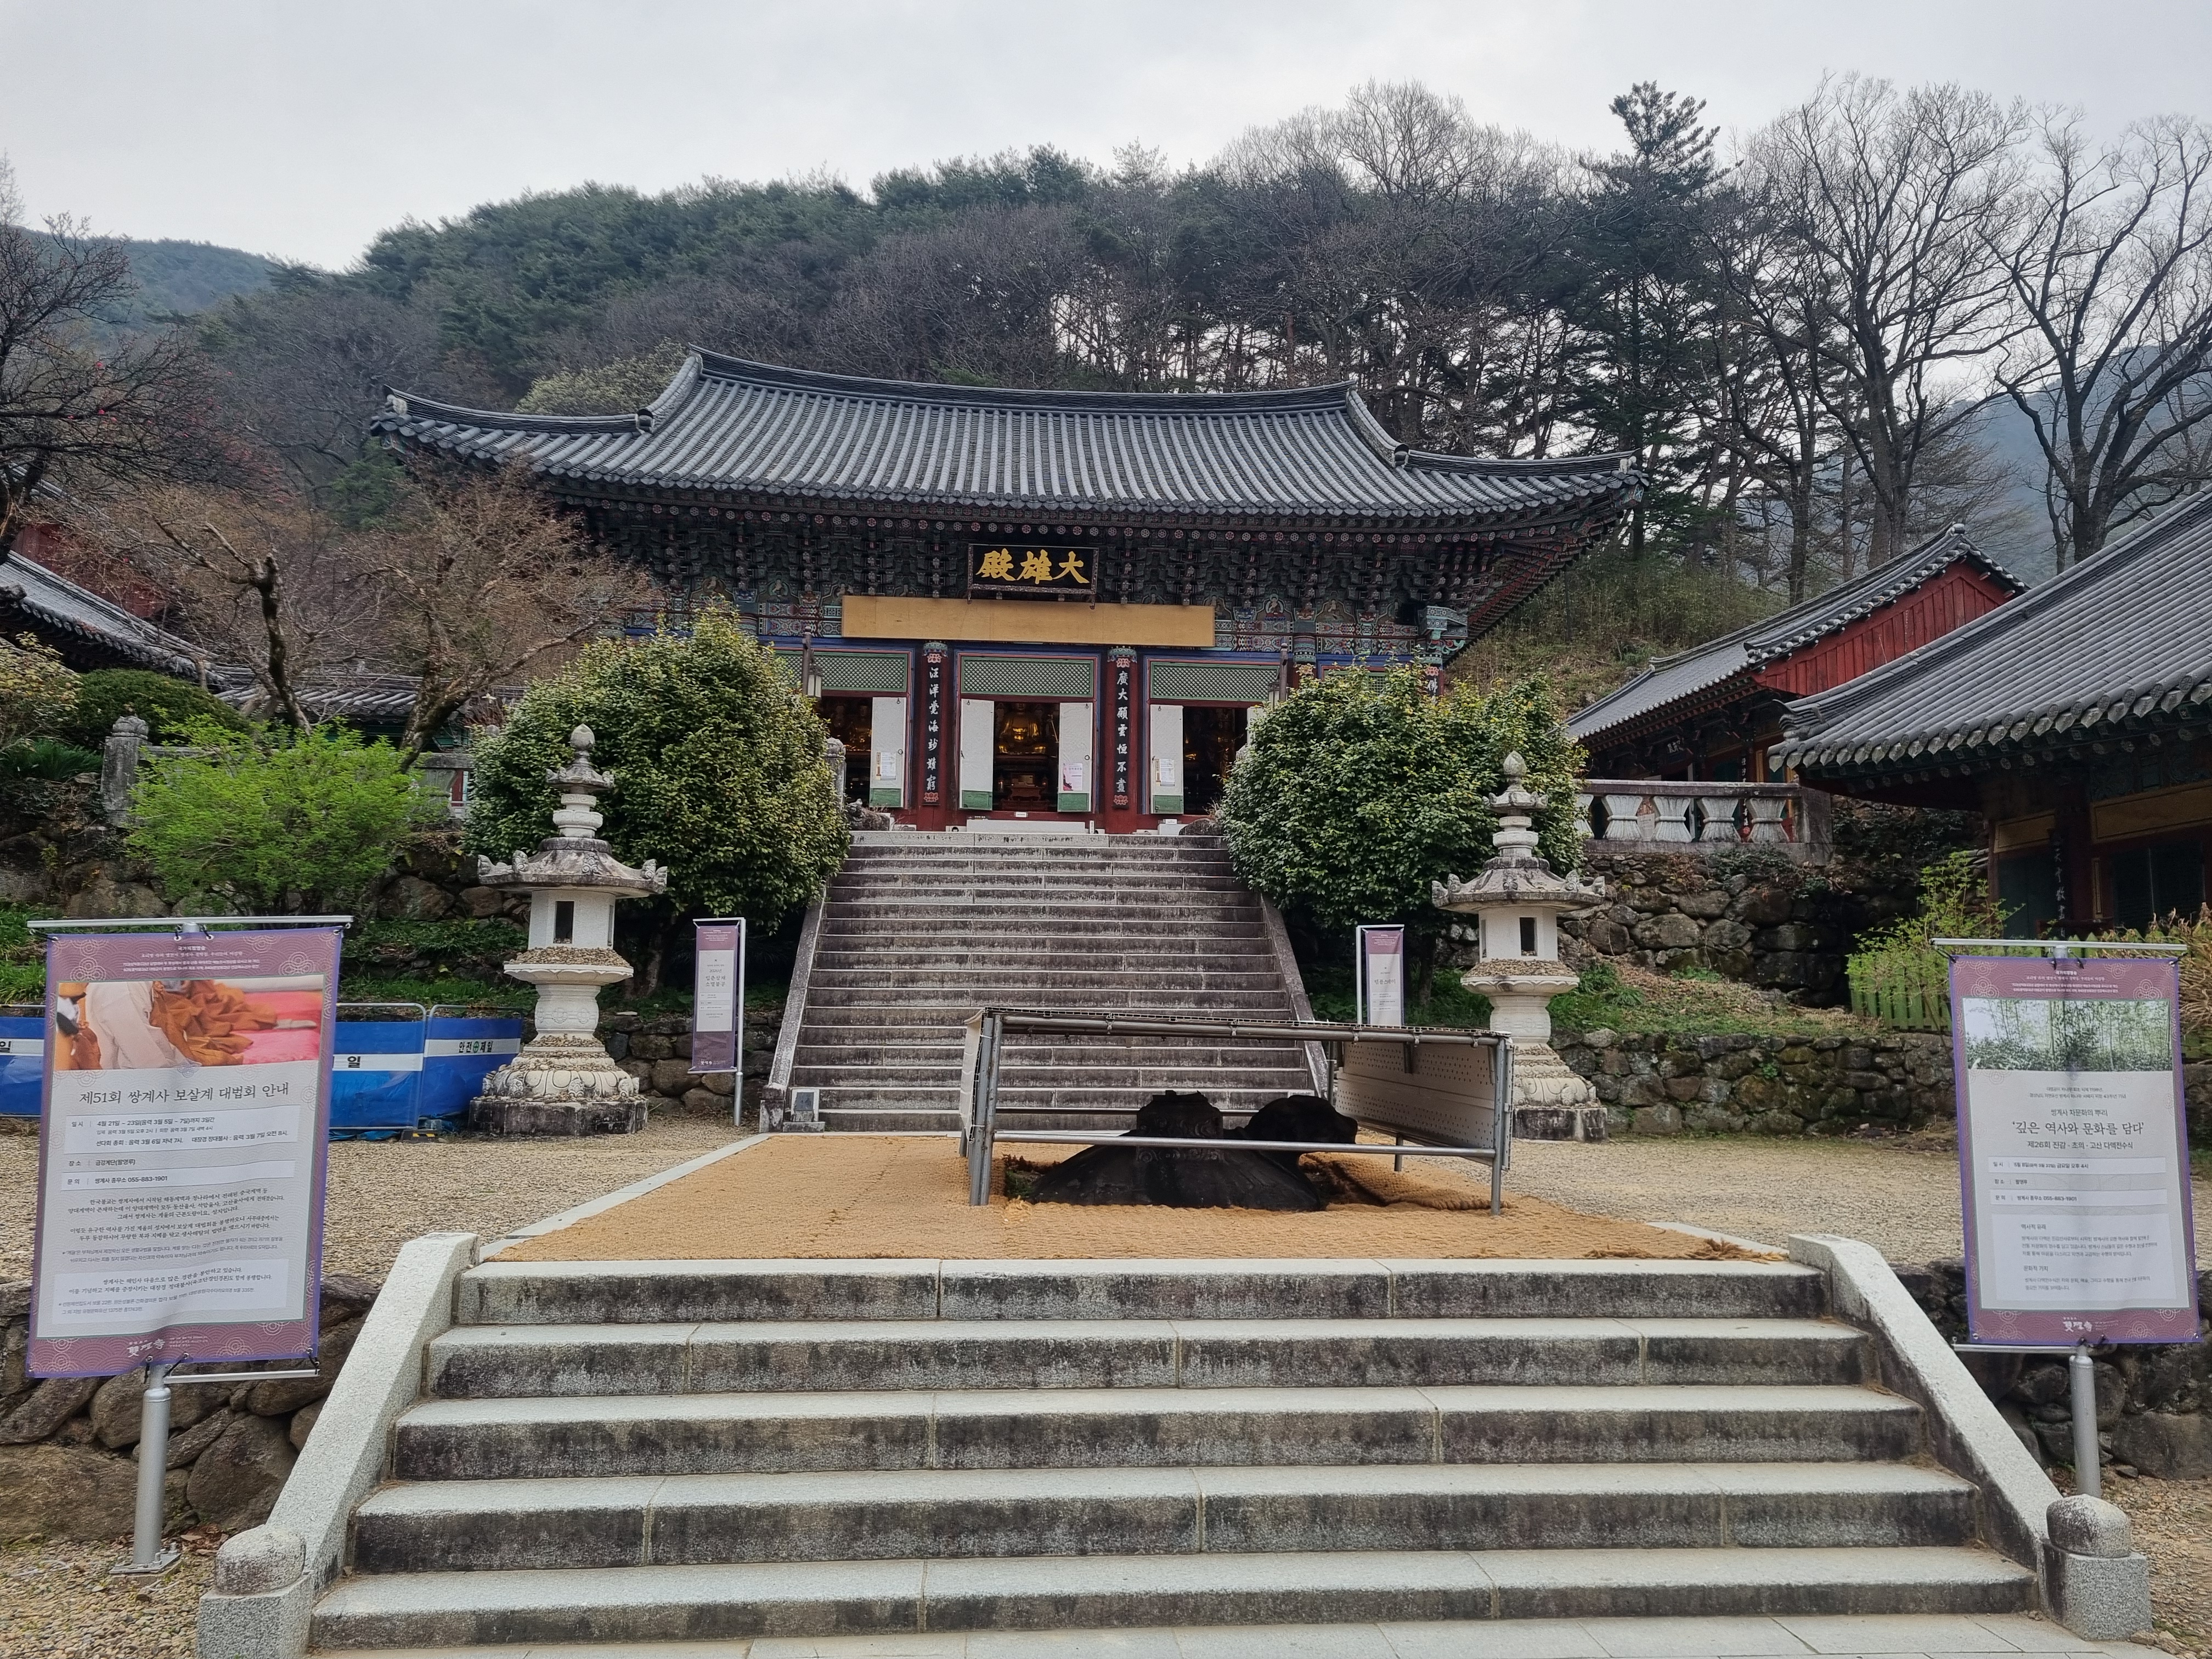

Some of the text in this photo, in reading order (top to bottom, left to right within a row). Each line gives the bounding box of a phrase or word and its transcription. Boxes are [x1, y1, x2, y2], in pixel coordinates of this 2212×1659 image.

[975, 548, 1090, 584] 大雄殿
[80, 1082, 289, 1104] 제51회 쌍계사 보살계 대법회 안내
[2045, 1122, 2079, 1135] 역사와
[2083, 1122, 2118, 1135] 문화를
